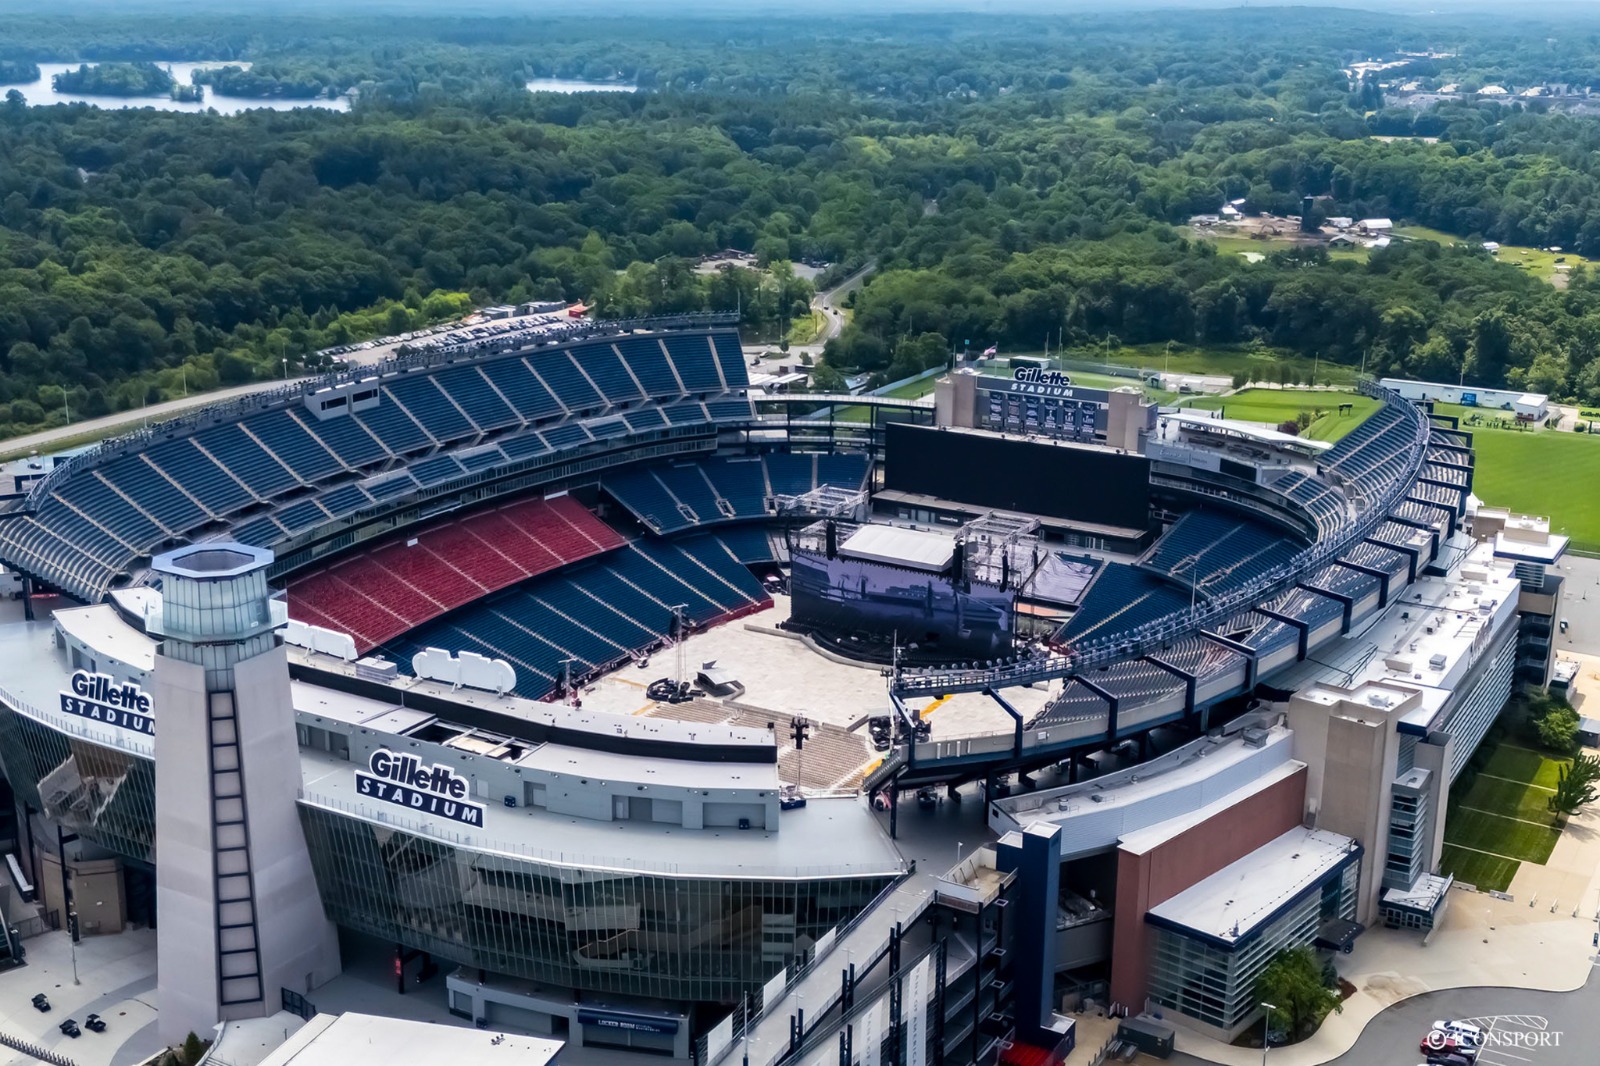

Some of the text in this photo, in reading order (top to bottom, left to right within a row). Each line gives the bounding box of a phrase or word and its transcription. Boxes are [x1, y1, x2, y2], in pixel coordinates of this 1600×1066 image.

[1011, 383, 1073, 397] STADIUM
[1014, 367, 1070, 386] Gillette
[71, 671, 151, 714] Gillette
[370, 750, 466, 799] Gillette
[361, 778, 478, 823] STADIUM
